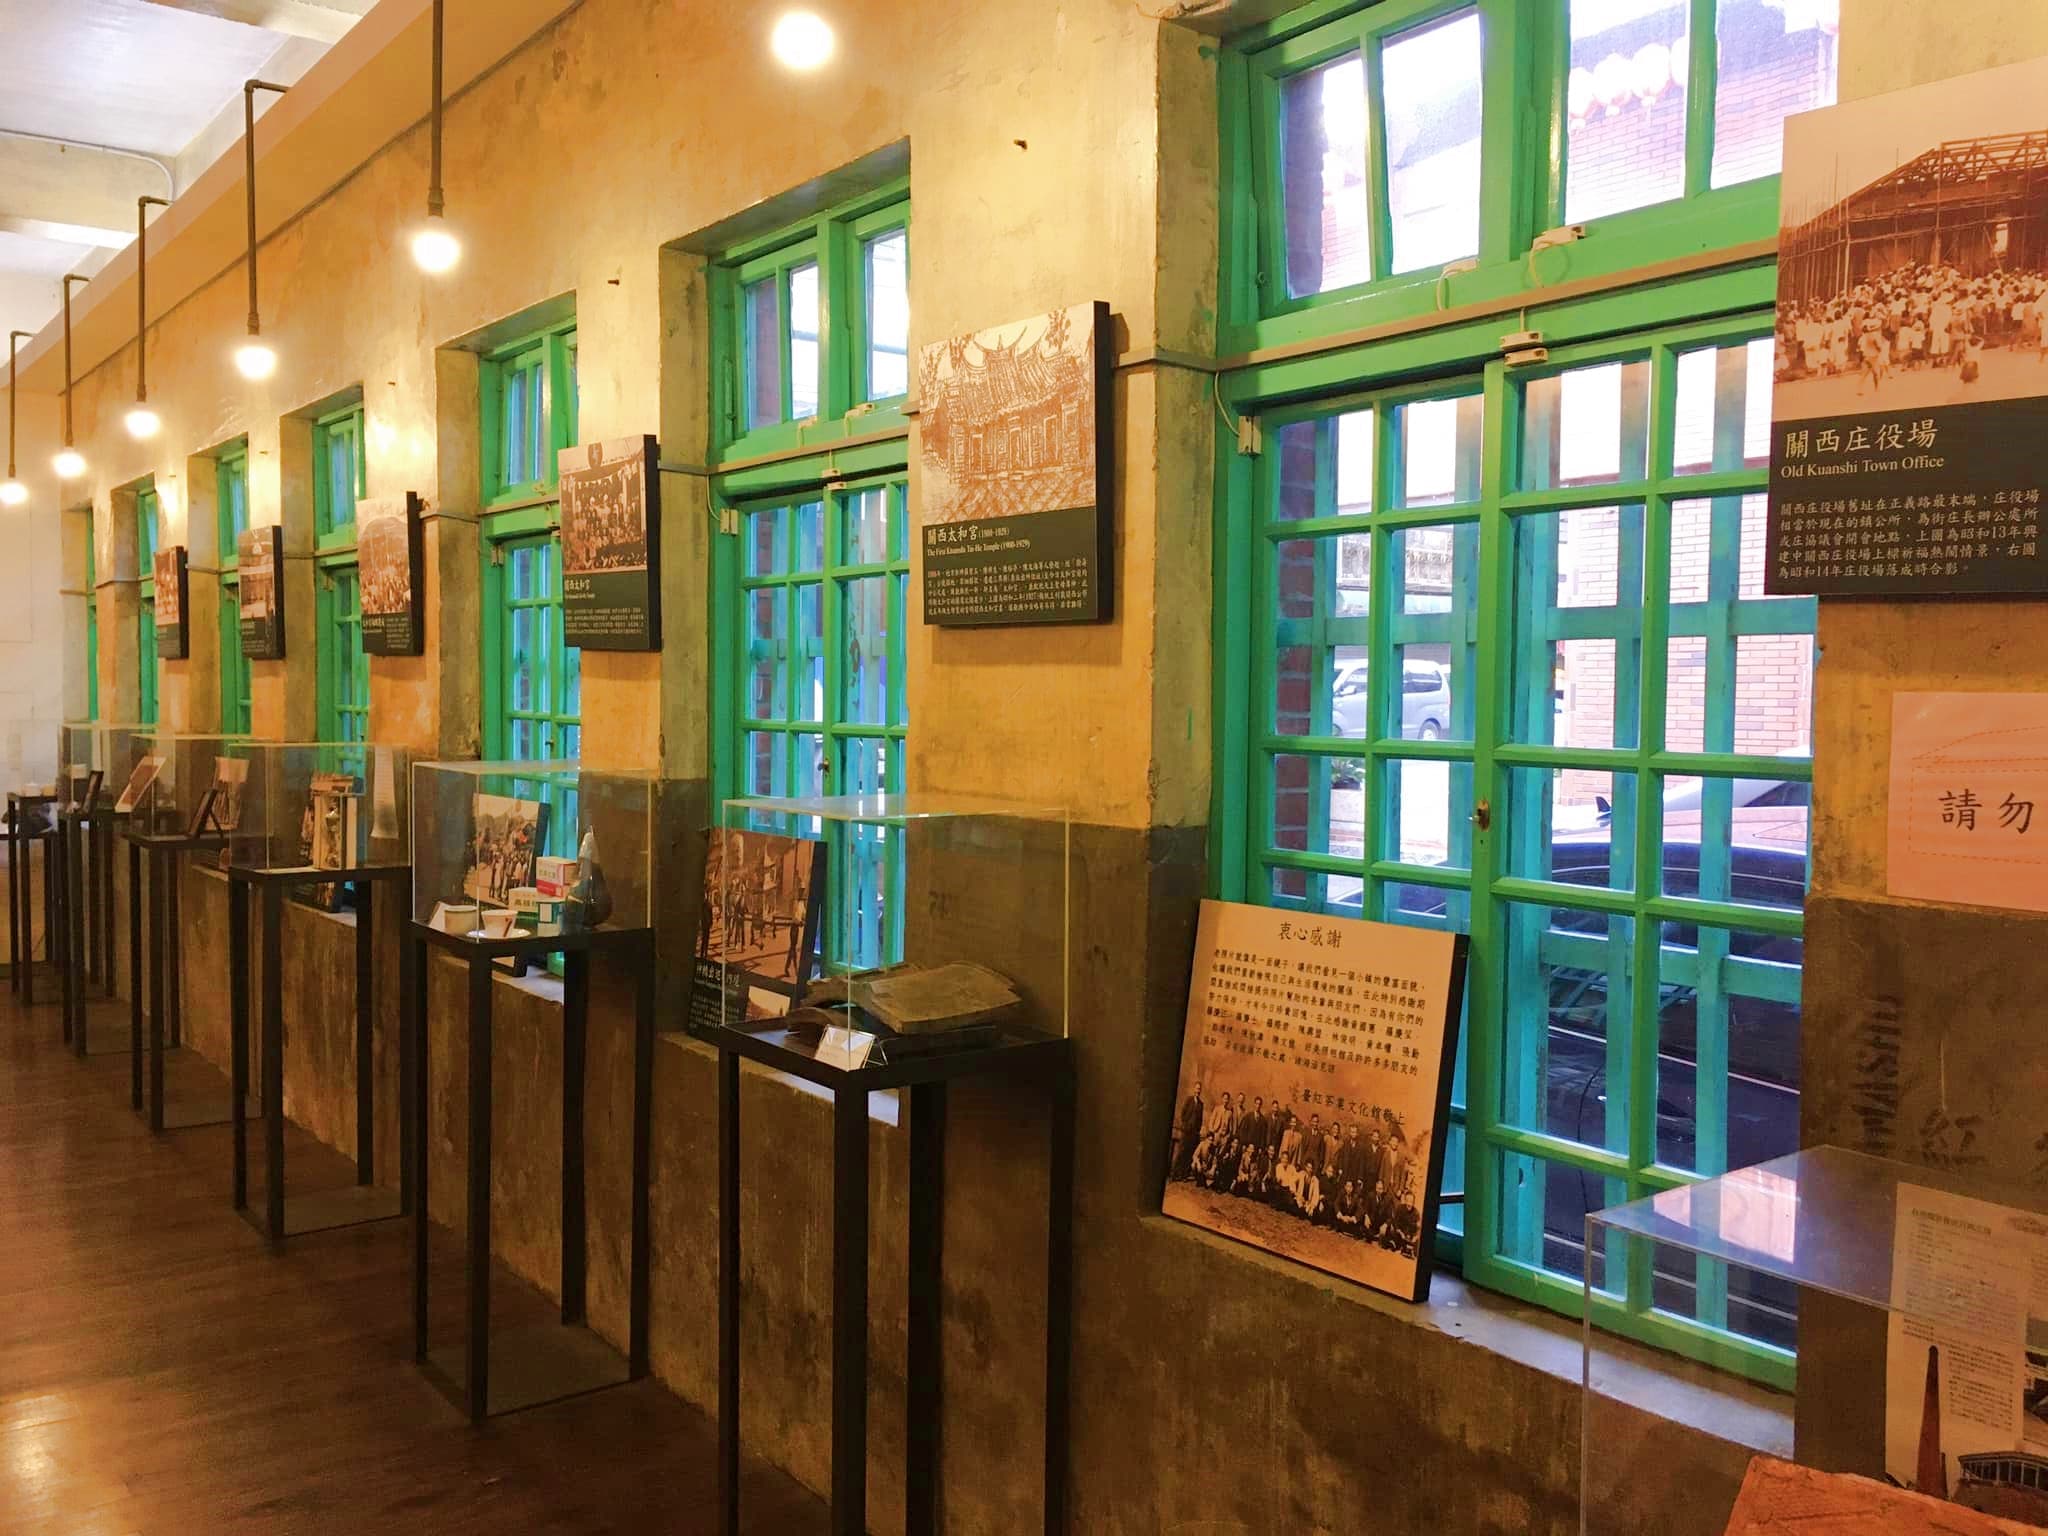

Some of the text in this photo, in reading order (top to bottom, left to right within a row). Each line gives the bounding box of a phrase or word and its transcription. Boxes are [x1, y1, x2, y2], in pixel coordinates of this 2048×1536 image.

[1785, 419, 1938, 459] 關西庄役場
[1781, 455, 1944, 478] Old Kuanshi Town Office
[927, 525, 978, 545] 關西太和宮
[1938, 788, 2034, 834] 請勿
[1278, 921, 1343, 949] 衷心感謝
